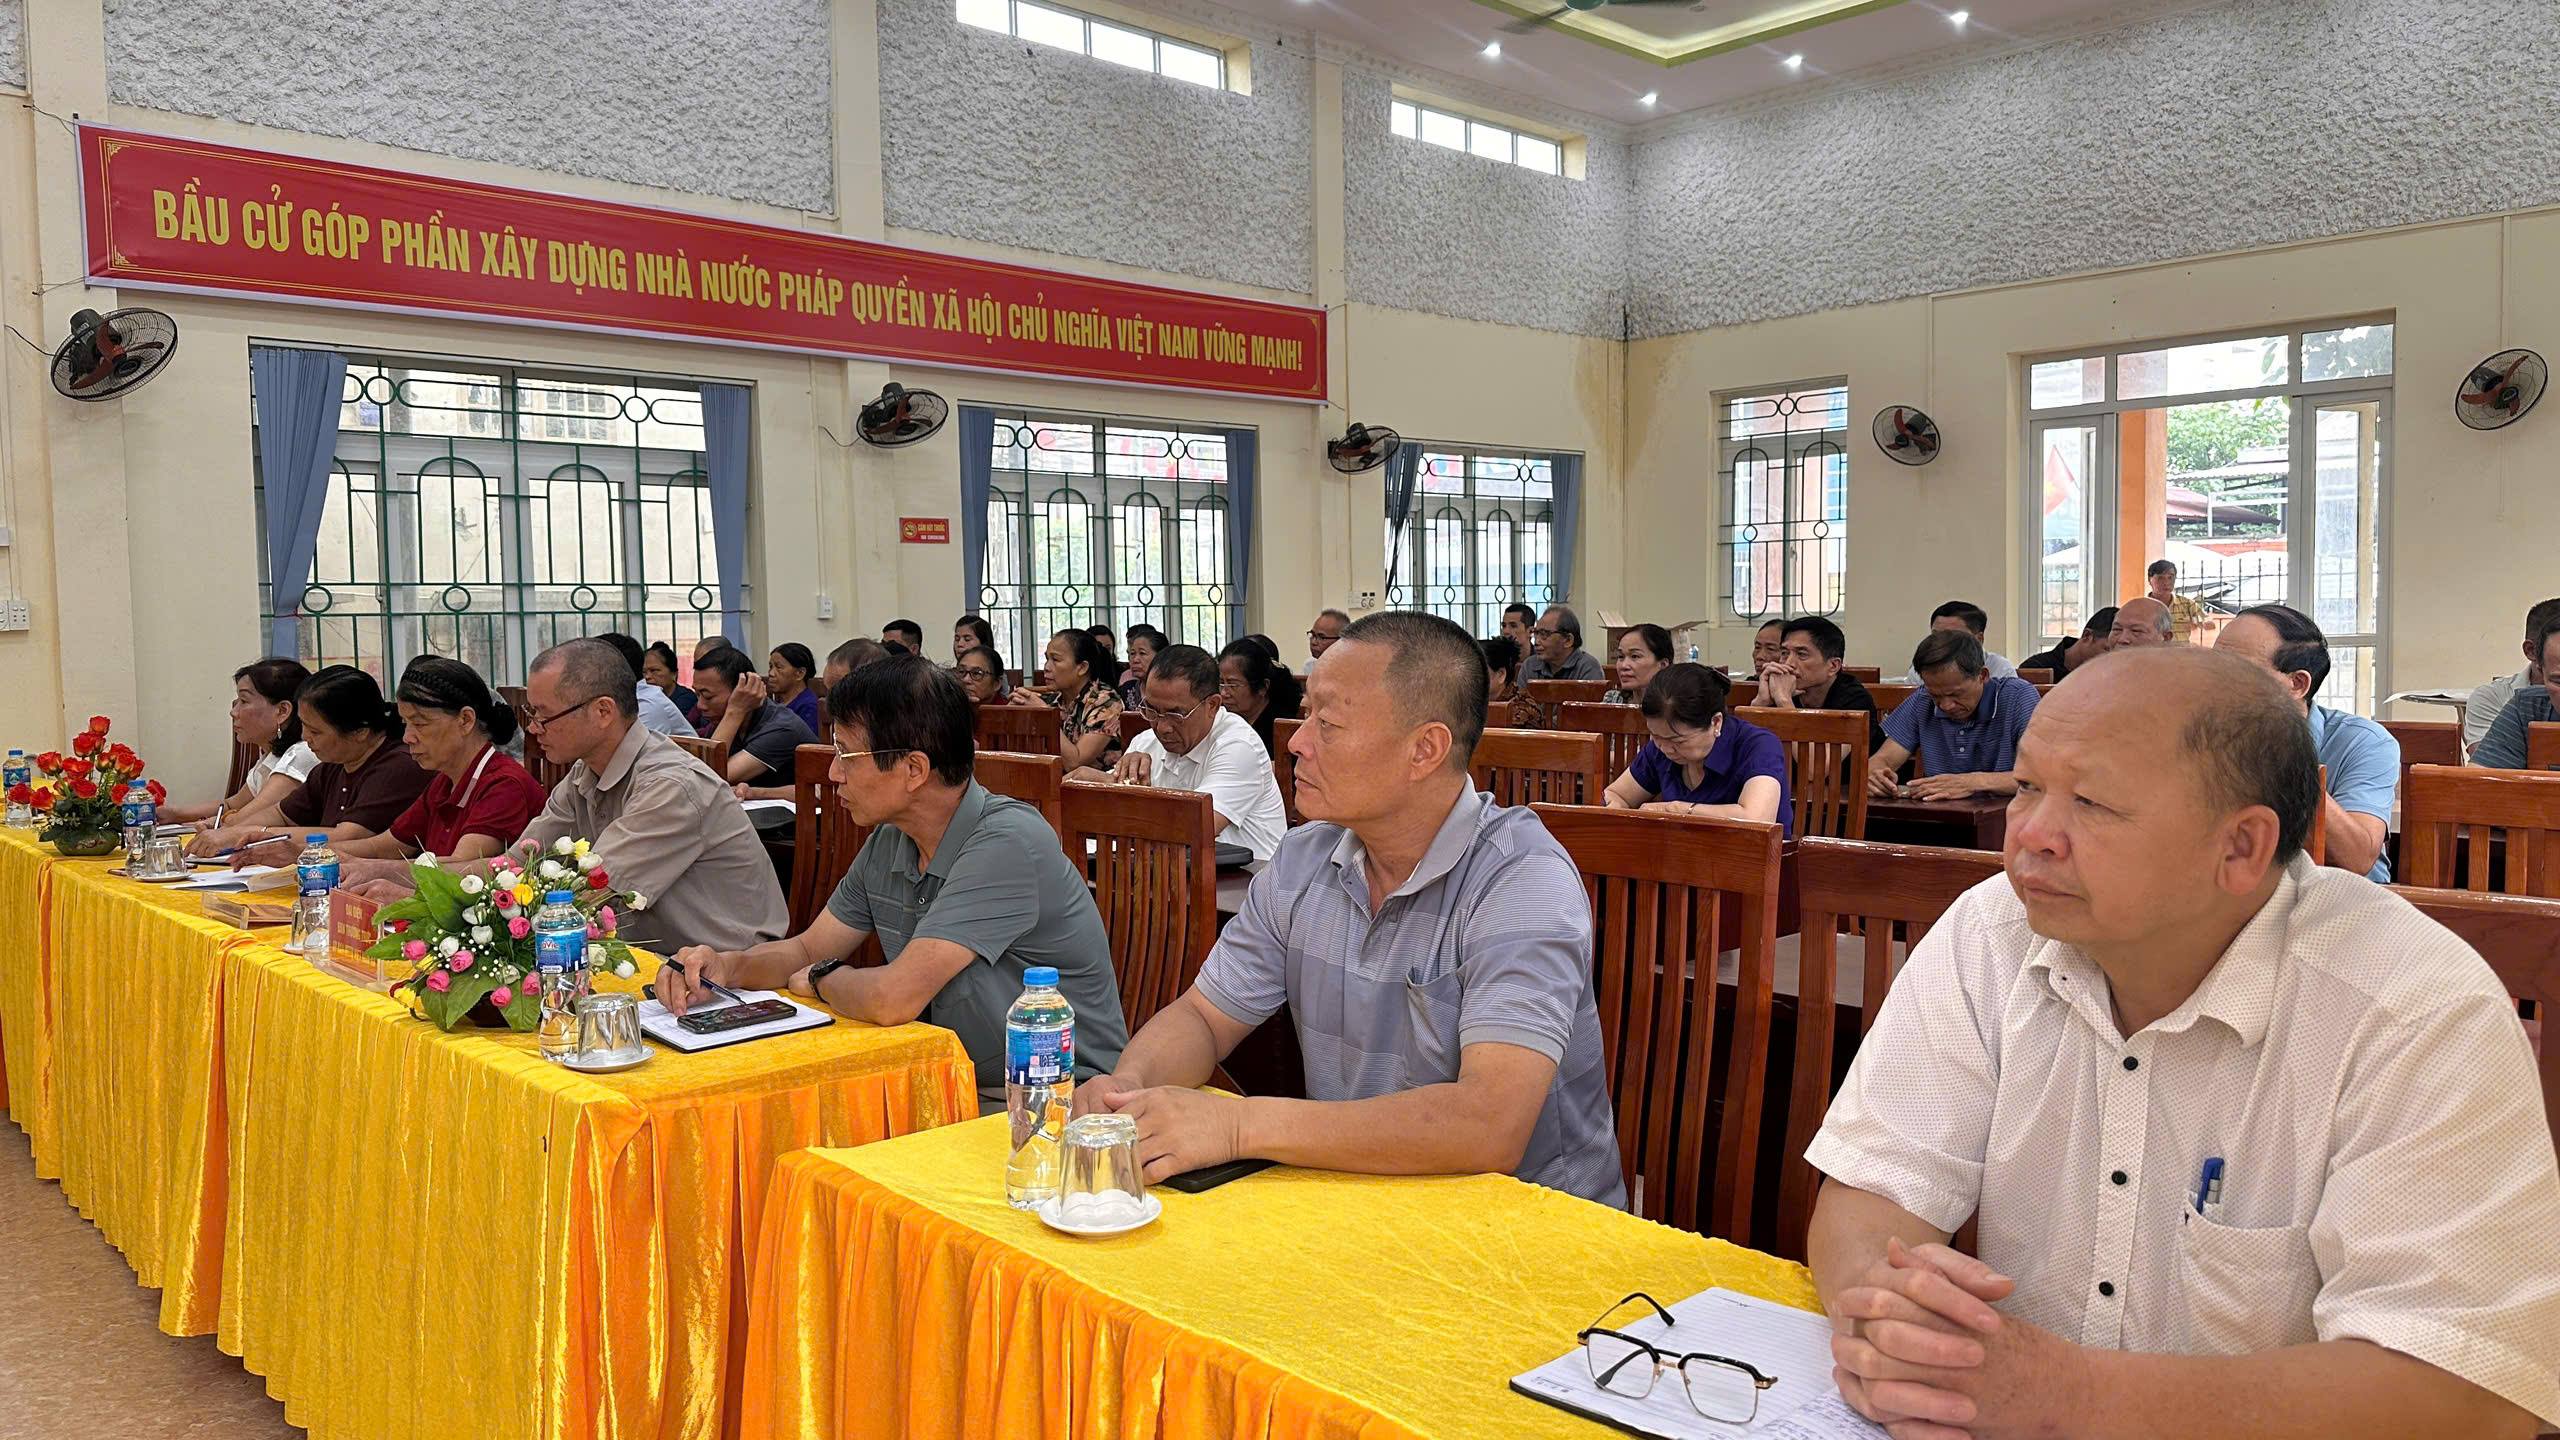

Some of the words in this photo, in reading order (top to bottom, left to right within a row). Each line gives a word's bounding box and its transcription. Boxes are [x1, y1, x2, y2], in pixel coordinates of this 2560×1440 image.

[153, 177, 230, 245] BẦU
[242, 184, 293, 252] CỬ
[301, 202, 369, 260] GÓP
[381, 210, 470, 272] PHẦN
[479, 226, 538, 280] XÂY
[548, 241, 627, 295] DỰNG
[635, 249, 693, 298] NHÀ
[700, 254, 771, 309] NƯỚC
[778, 268, 843, 316] PHÁP
[851, 275, 926, 327] QUYỀN
[932, 288, 962, 332] XÃ
[967, 292, 1002, 344] HỘI
[1008, 292, 1048, 343] CHỦ
[1053, 308, 1112, 350] NGHĨA
[1116, 313, 1153, 360] VIỆT
[1158, 323, 1198, 359] NAM
[1203, 322, 1246, 365] VỮNG
[1251, 335, 1303, 375] MẠNH!
